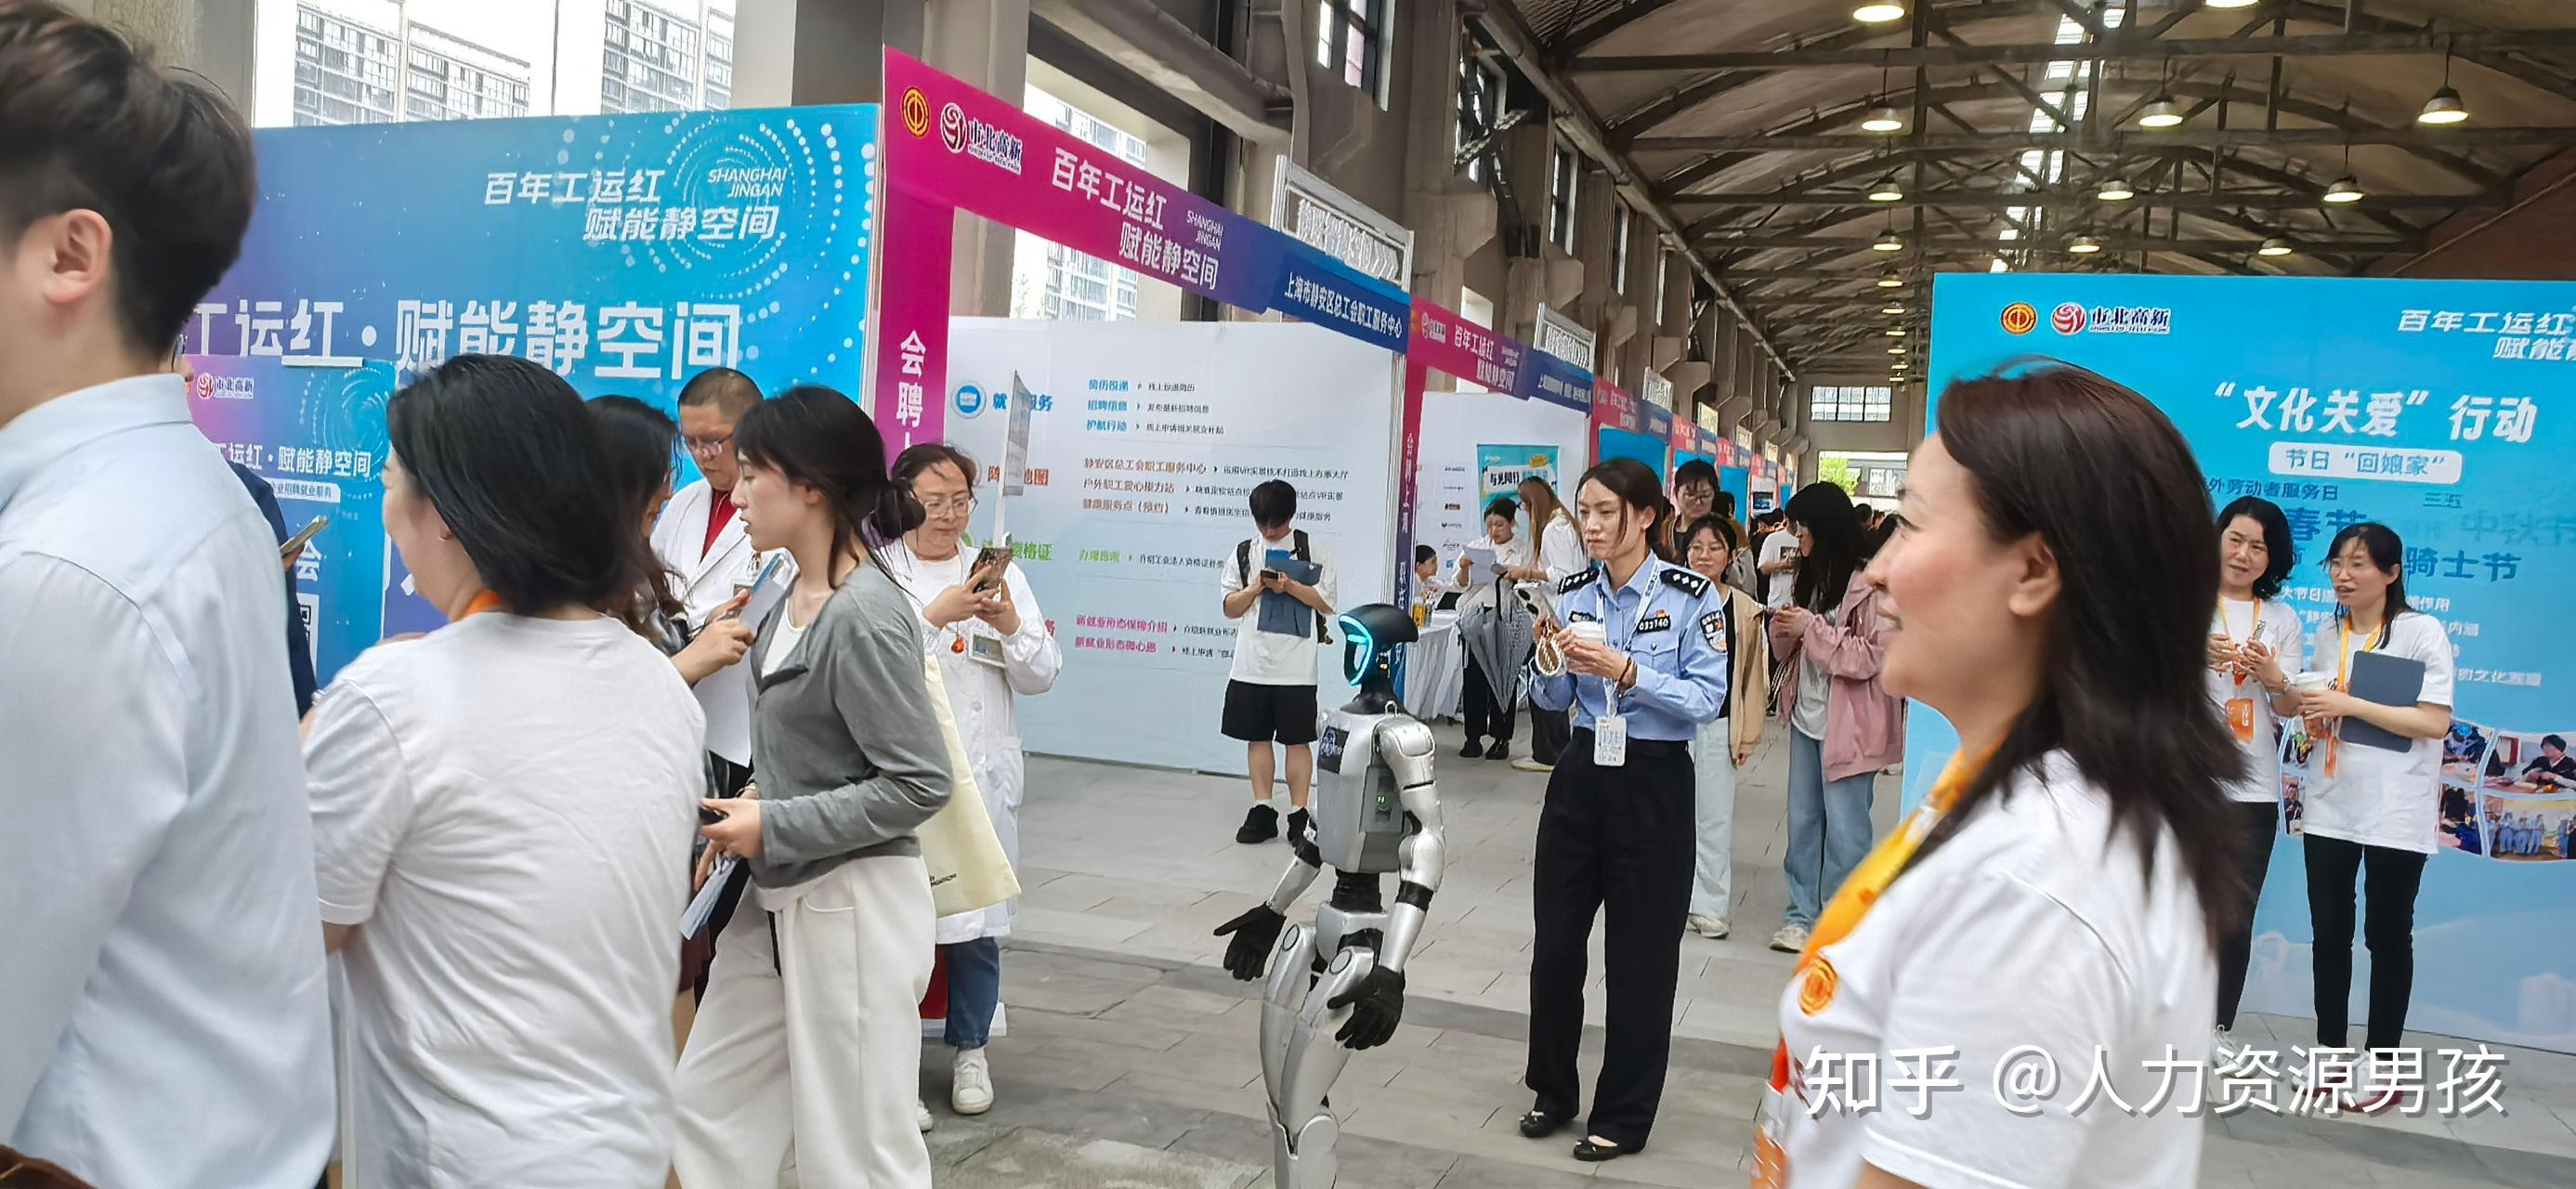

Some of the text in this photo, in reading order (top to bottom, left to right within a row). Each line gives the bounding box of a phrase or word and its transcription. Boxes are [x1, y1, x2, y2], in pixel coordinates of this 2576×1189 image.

[970, 121, 1021, 161] 市北高新
[485, 169, 665, 204] 百年工运红
[709, 168, 788, 184] SHANGHAI
[727, 183, 784, 198] JINGAN
[1052, 147, 1167, 230] 百年工运红
[582, 205, 779, 241] 赋能静空间
[1186, 210, 1224, 237] SHANGHAI
[1118, 222, 1219, 290] 赋能静空间
[1285, 271, 1403, 339] 上海市静安区总工会职工服务中心
[2092, 307, 2169, 326] 市北高新
[2398, 309, 2576, 335] 百年工运红
[896, 330, 927, 450] 会聘
[2205, 477, 2338, 501] 外劳动者服务日
